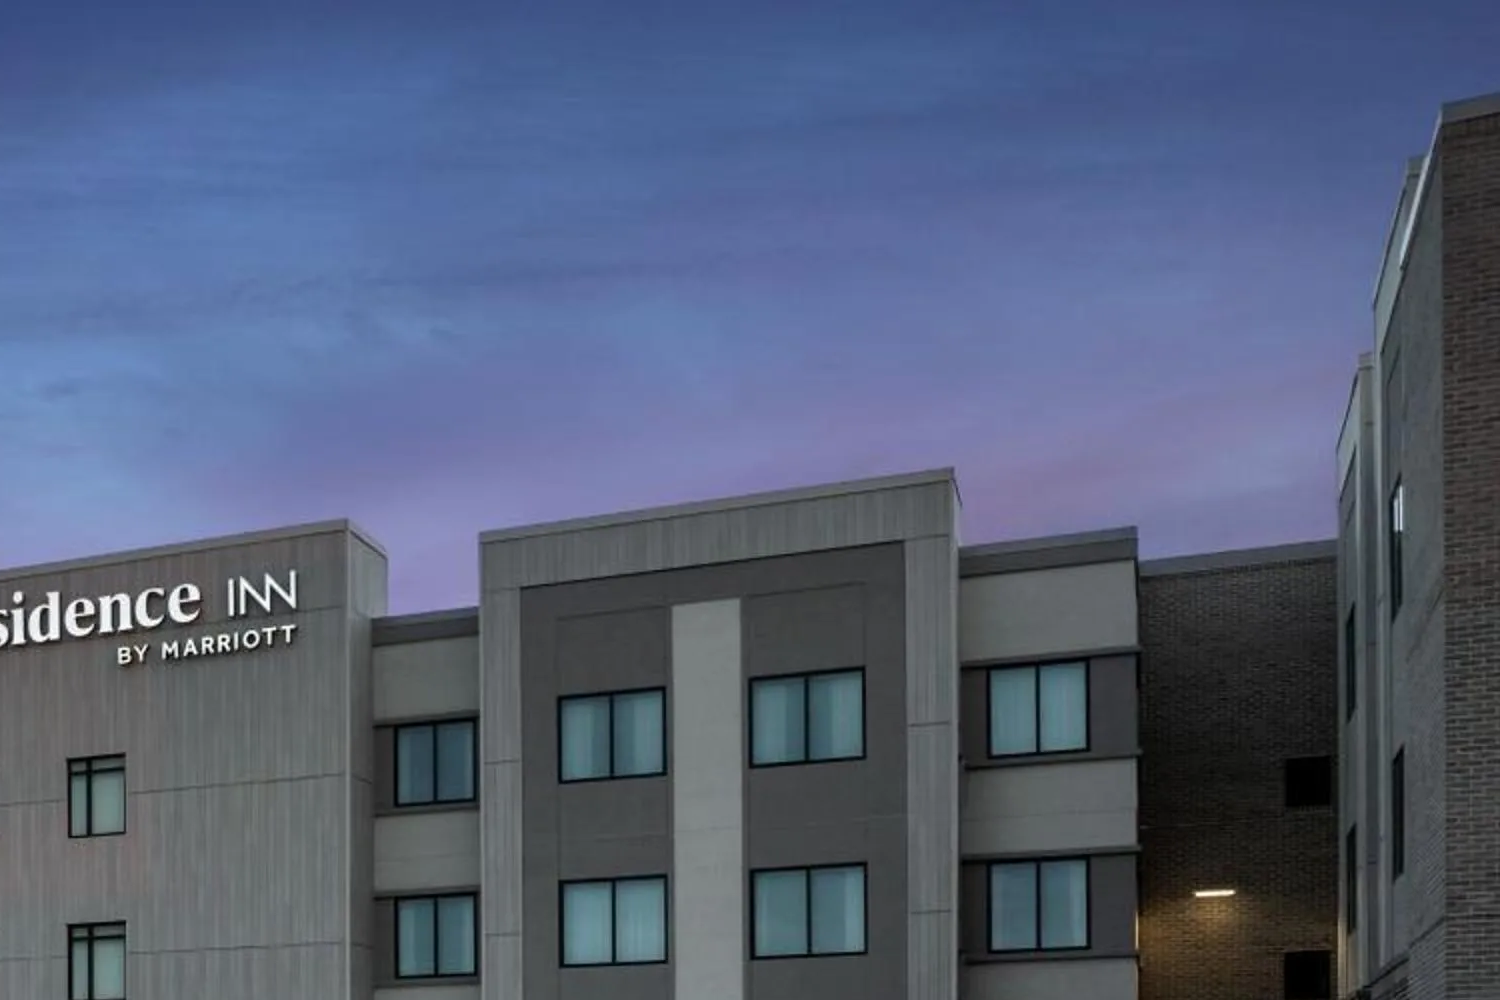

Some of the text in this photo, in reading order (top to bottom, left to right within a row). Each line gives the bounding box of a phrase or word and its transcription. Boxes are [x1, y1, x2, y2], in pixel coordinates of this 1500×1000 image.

[227, 570, 298, 617] INN
[117, 624, 298, 665] BY MARRIOTT
